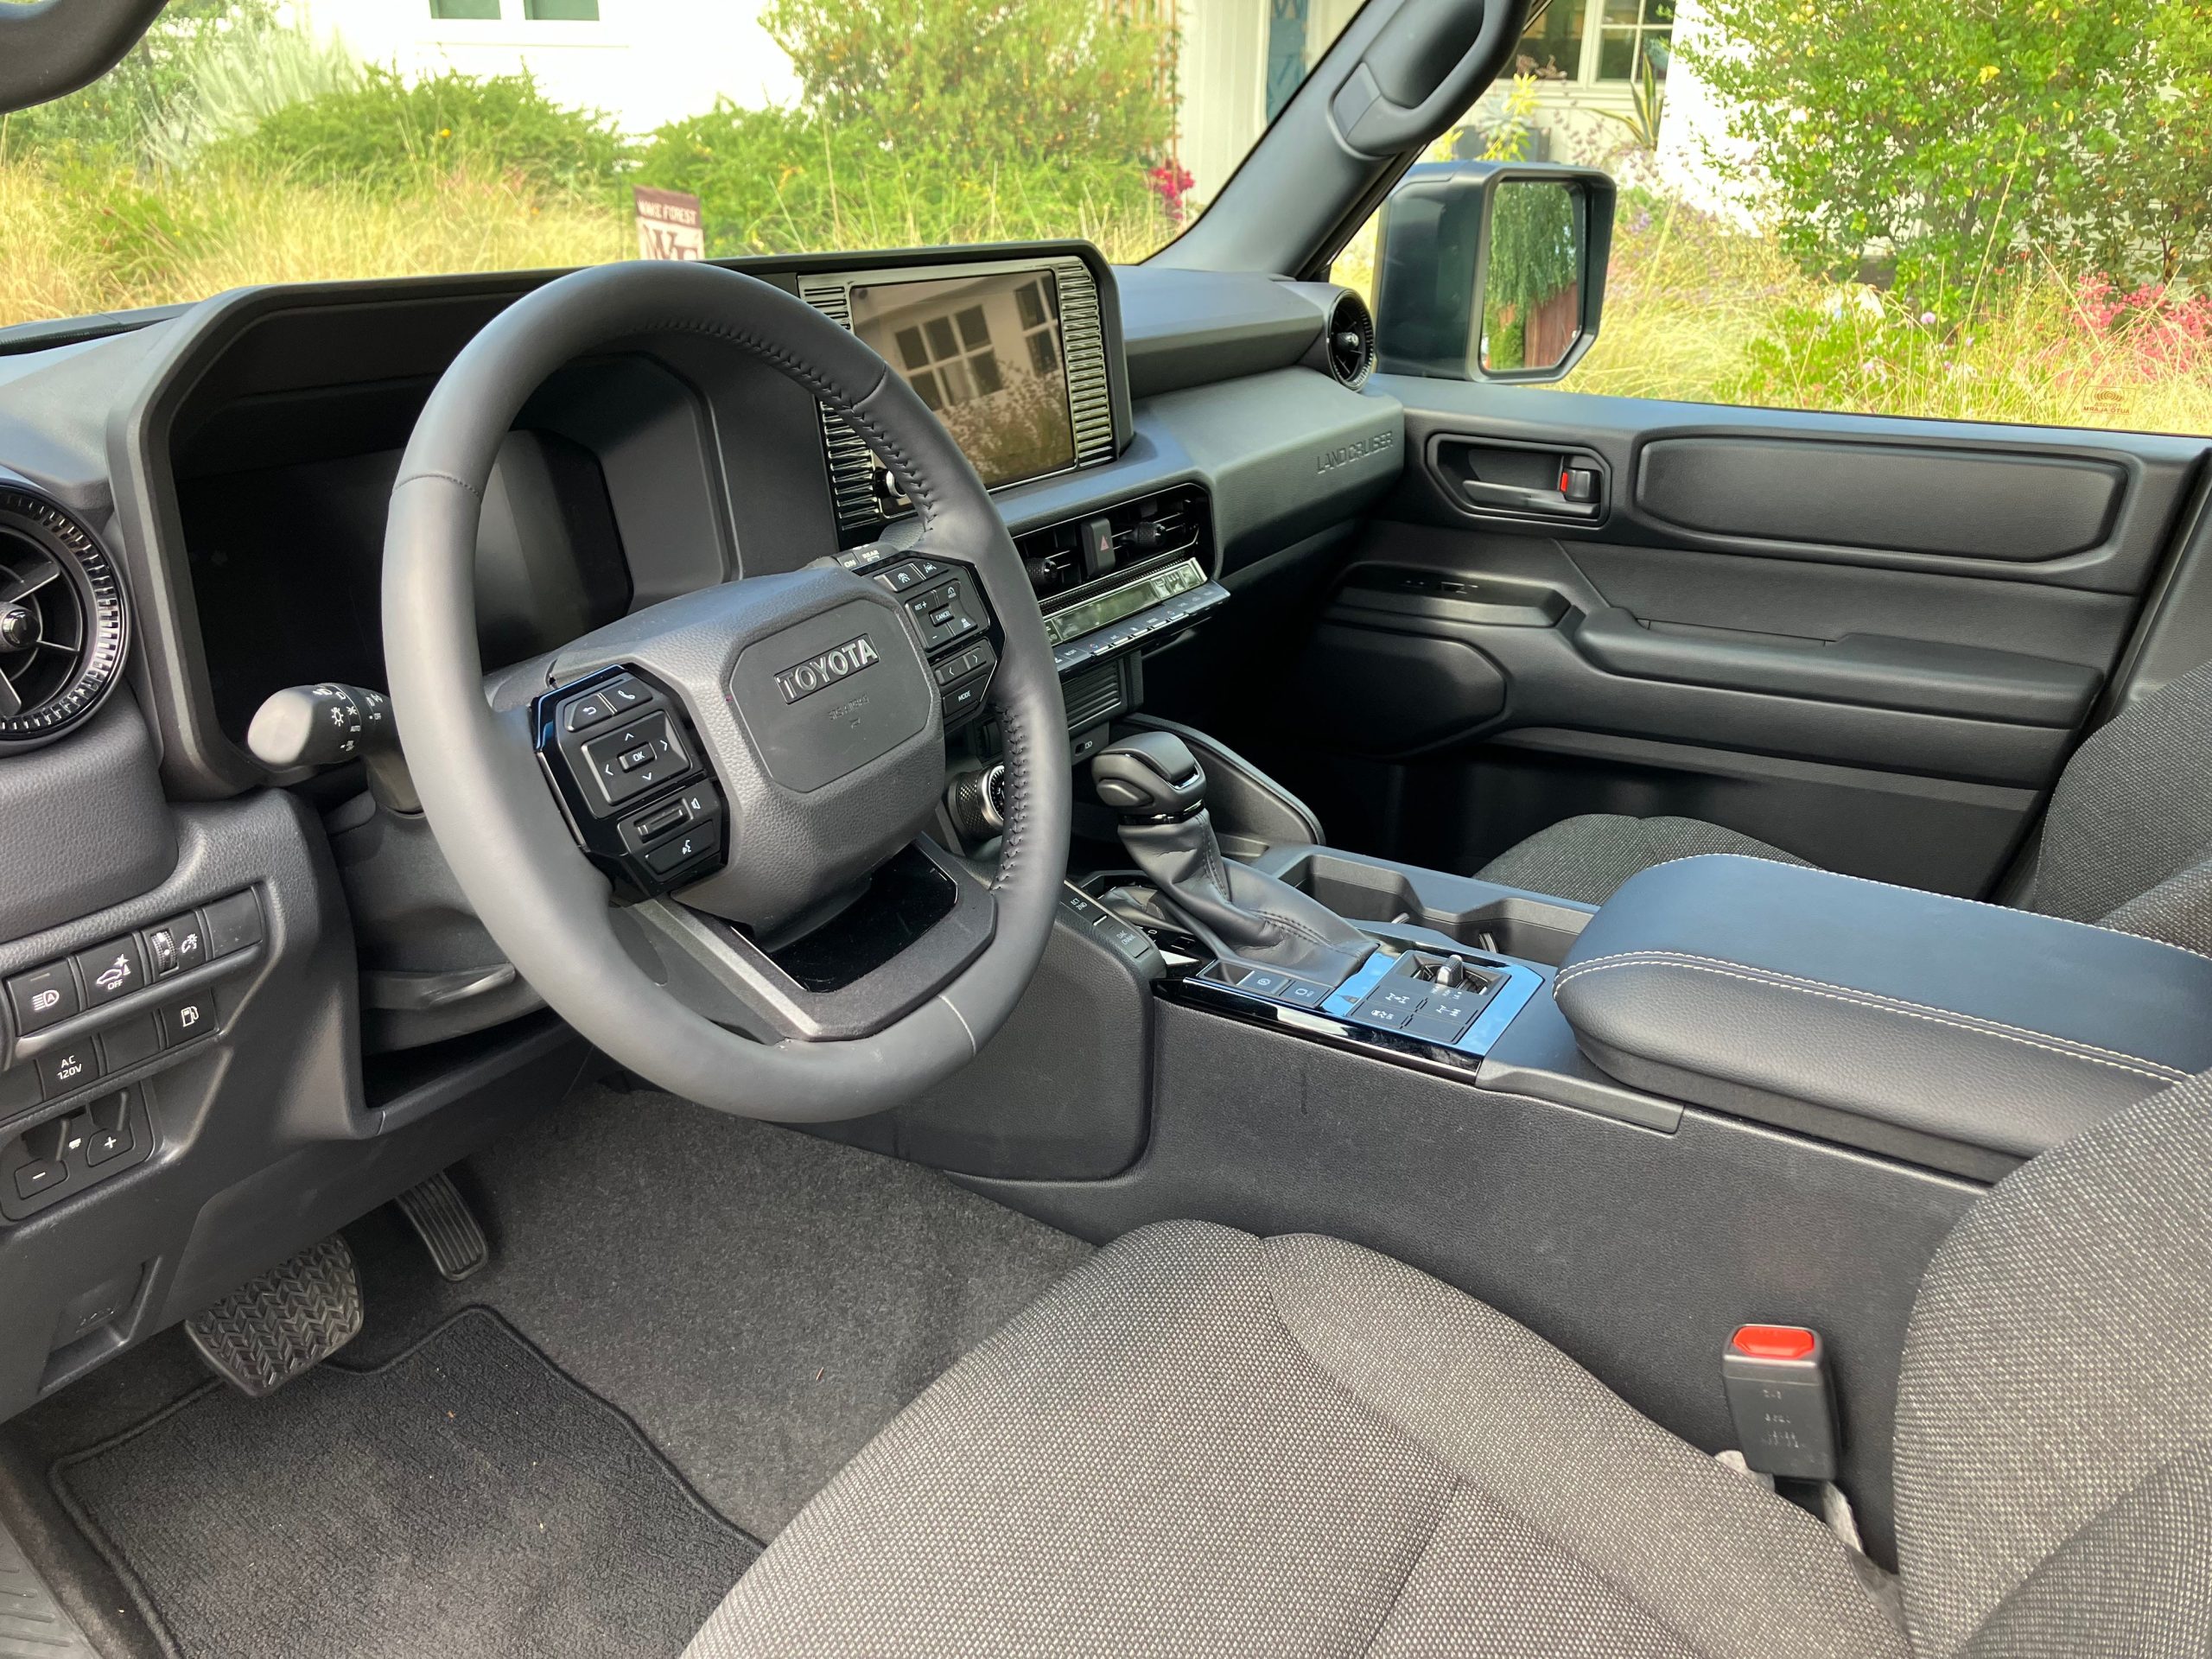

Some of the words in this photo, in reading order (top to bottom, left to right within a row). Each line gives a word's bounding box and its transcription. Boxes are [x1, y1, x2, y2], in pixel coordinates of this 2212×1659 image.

[636, 200, 663, 219] WAKE
[662, 204, 697, 226] FOREST
[1317, 448, 1347, 474] LAND
[1348, 430, 1393, 462] CRUISER
[843, 559, 857, 569] ON
[935, 610, 951, 621] CANCEL
[776, 639, 878, 700] TOYOTA
[958, 690, 970, 701] MODE
[632, 751, 645, 762] OK
[107, 978, 124, 990] OFF
[61, 1056, 76, 1068] AC
[57, 1064, 82, 1080] 120V
